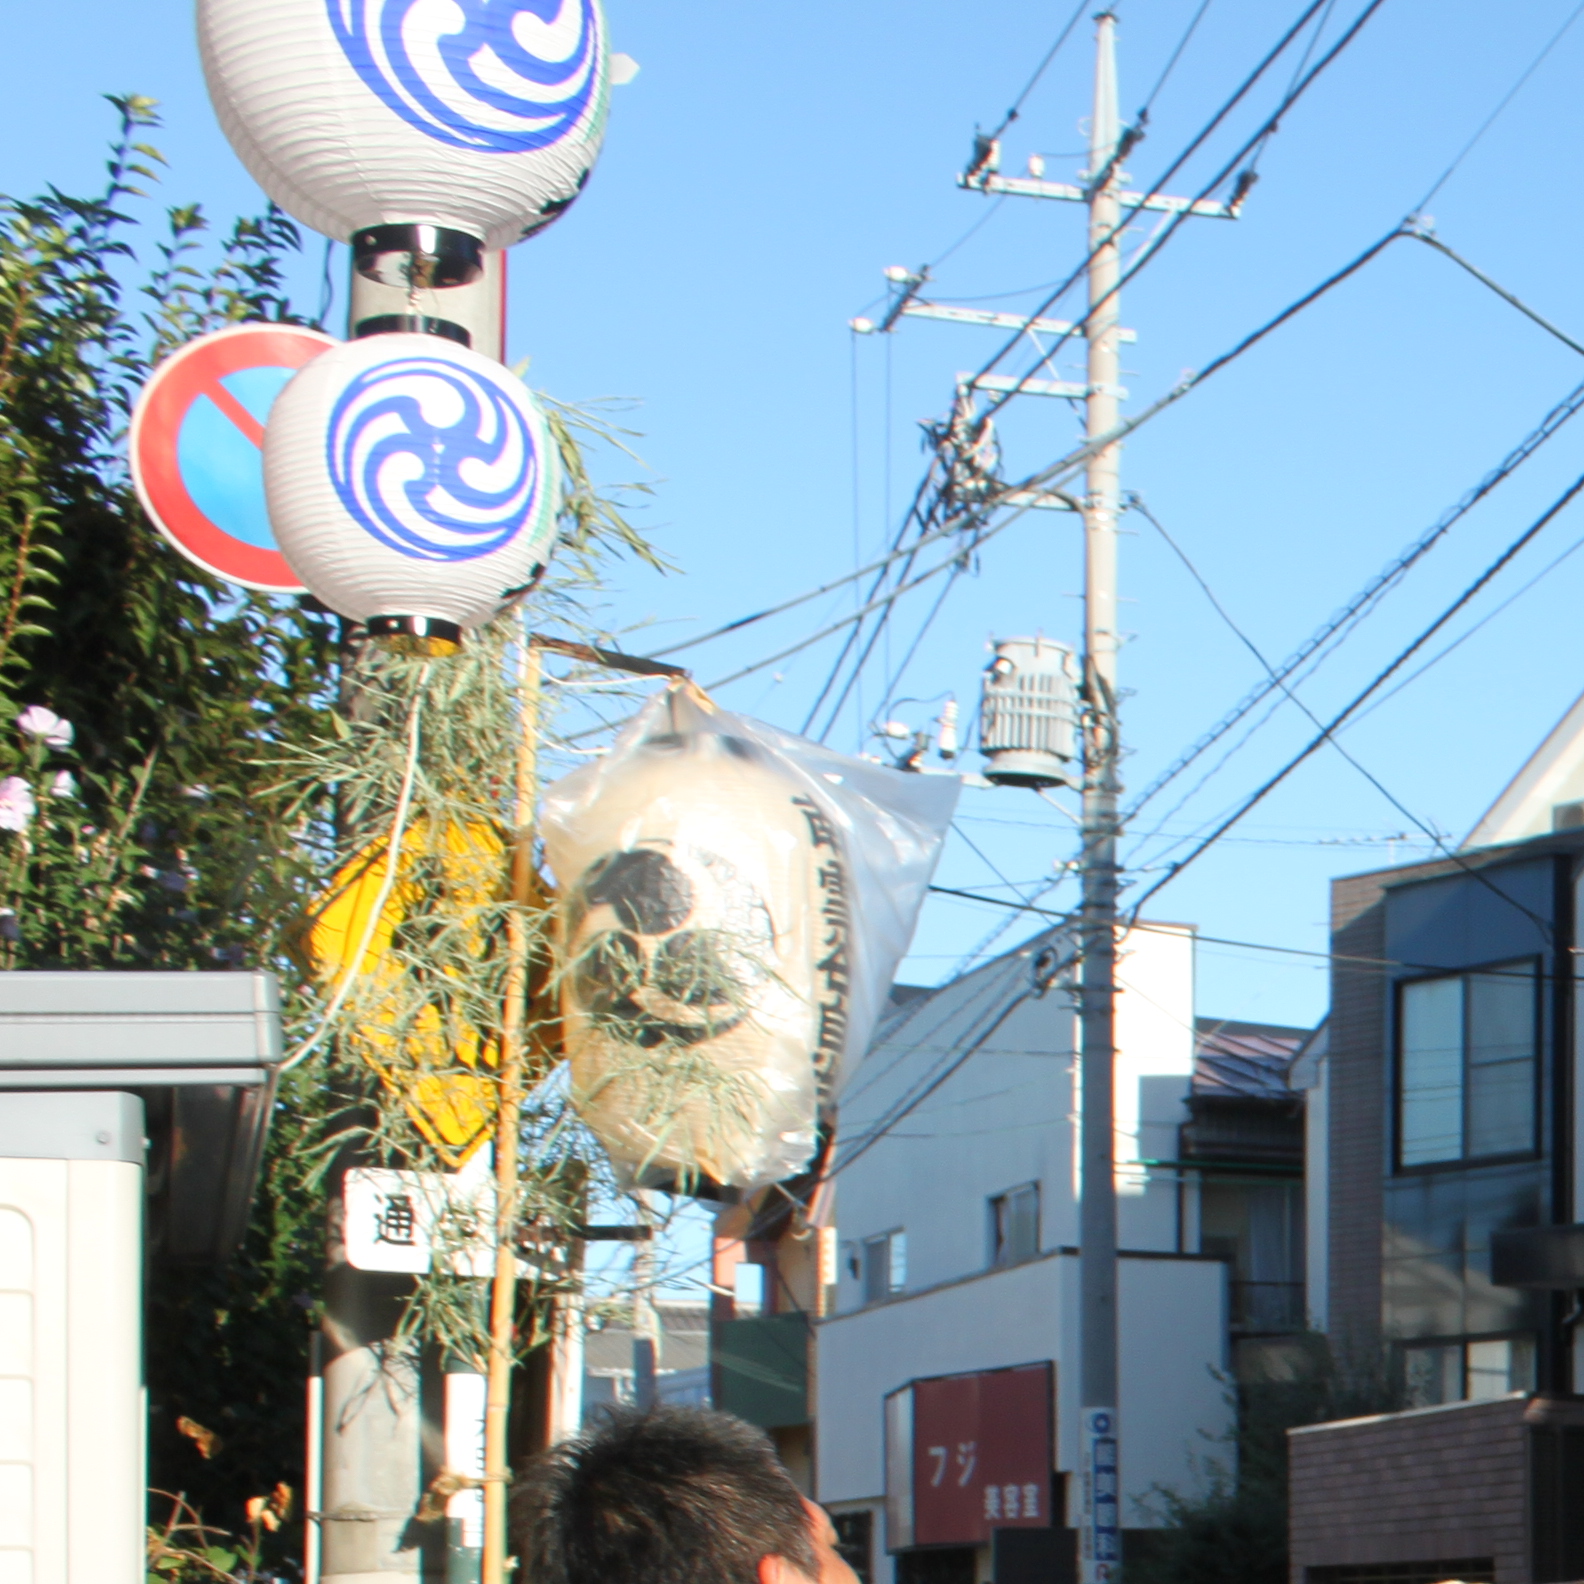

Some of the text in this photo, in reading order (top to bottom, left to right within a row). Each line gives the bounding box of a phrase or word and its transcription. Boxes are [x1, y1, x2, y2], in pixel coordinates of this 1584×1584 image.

[927, 1440, 979, 1488] フジ
[984, 1483, 1041, 1520] 美容室
